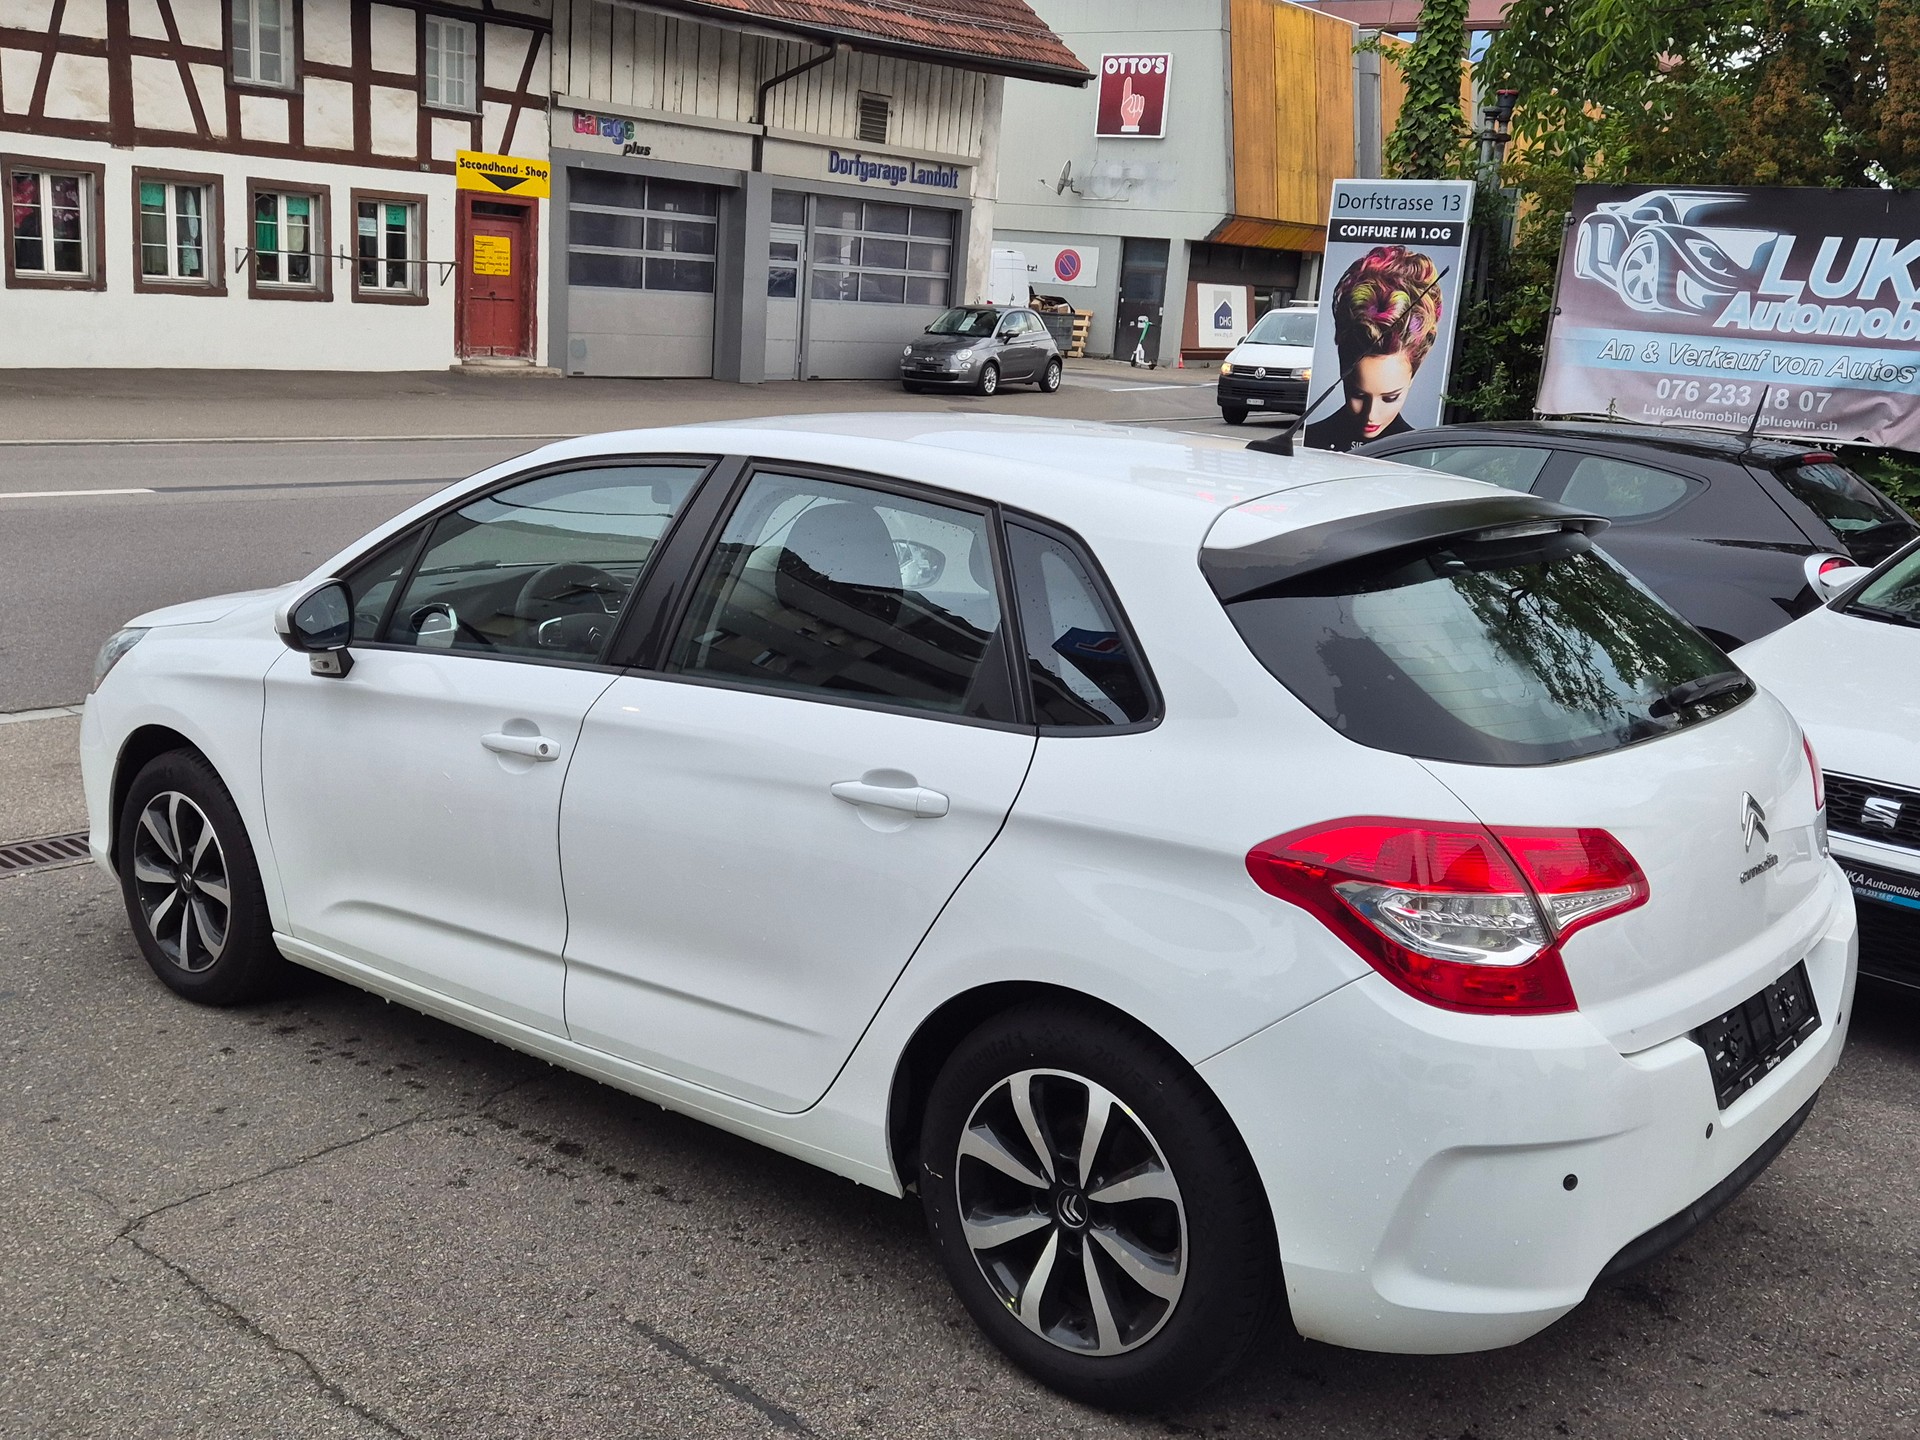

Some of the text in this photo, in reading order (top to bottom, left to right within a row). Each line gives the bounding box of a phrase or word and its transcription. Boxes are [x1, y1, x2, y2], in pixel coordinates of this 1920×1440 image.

[1105, 57, 1165, 74] OTTO'S
[573, 110, 635, 145] Garage
[622, 141, 651, 156] plus
[459, 158, 518, 174] Secondhand
[525, 166, 548, 180] Shop
[828, 150, 959, 189] Dorfgarage Landolt
[1338, 192, 1461, 211] Dorfstrasse 13
[1340, 225, 1452, 240] COIFFURE IM 1.OG
[1757, 234, 1920, 301] LUK
[1712, 290, 1920, 342] Automob
[1597, 338, 1917, 384] An & Verkauf von Autos
[1656, 378, 1700, 402] 076
[1706, 382, 1751, 407] 233
[1798, 390, 1832, 414] 07
